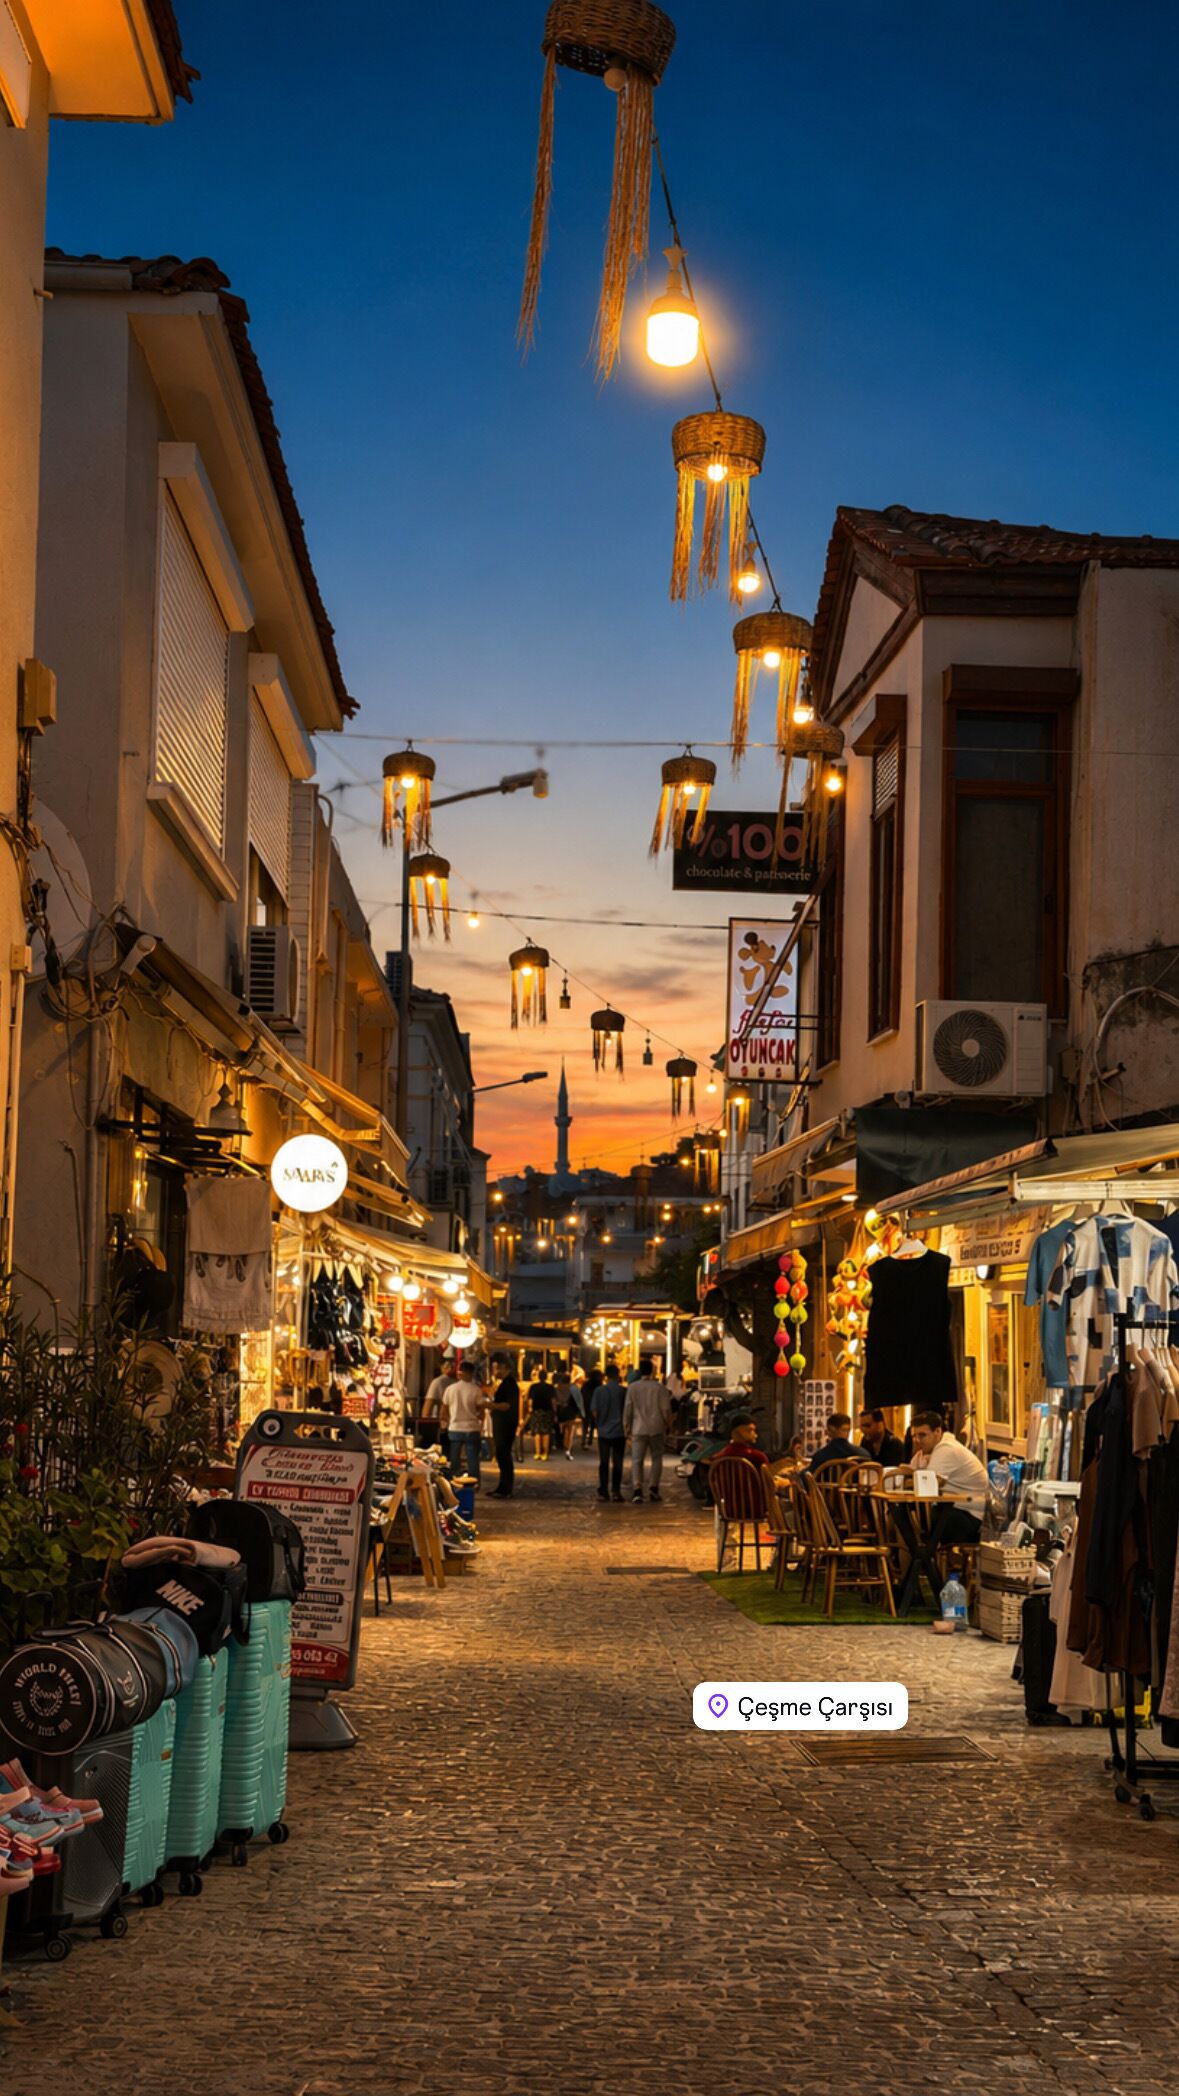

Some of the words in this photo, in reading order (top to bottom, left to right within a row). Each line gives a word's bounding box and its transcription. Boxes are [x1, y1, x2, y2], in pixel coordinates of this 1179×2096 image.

[686, 864, 741, 880] chocolate
[743, 868, 752, 879] &
[755, 867, 812, 882] patisserie
[730, 1038, 796, 1066] OYUNCAK
[155, 1579, 204, 1615] NIKE
[14, 1662, 57, 1688] WORLD
